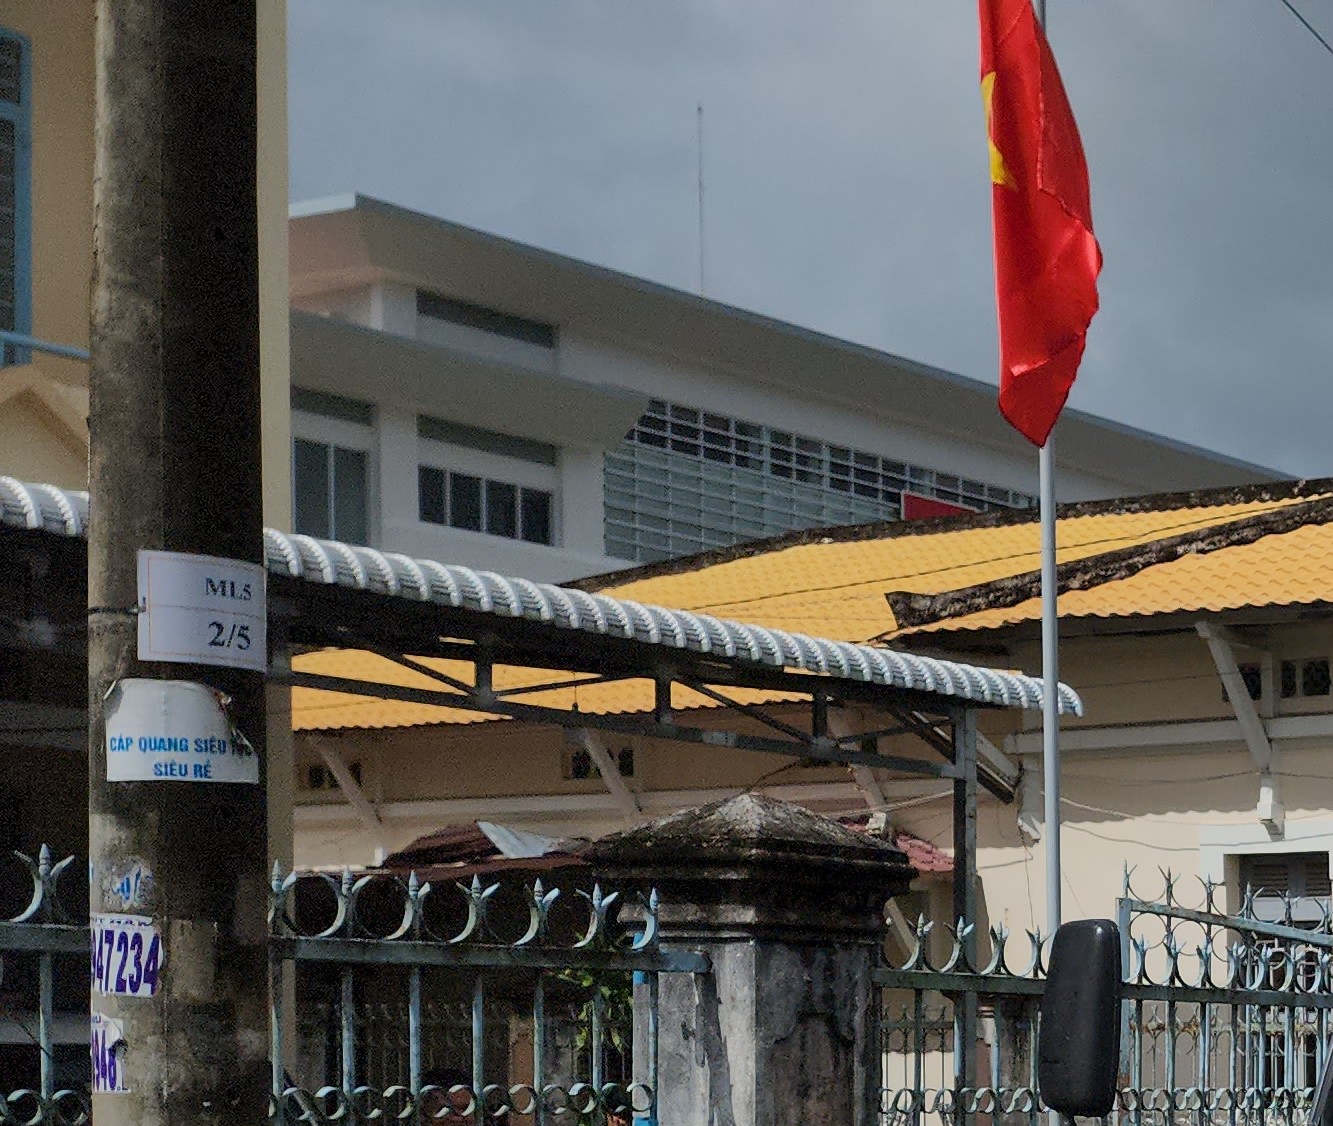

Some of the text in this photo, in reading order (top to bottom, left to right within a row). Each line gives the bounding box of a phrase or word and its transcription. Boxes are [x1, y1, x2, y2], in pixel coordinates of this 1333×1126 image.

[205, 577, 252, 601] ML5
[208, 621, 251, 650] 2/5
[139, 737, 189, 753] QUANG
